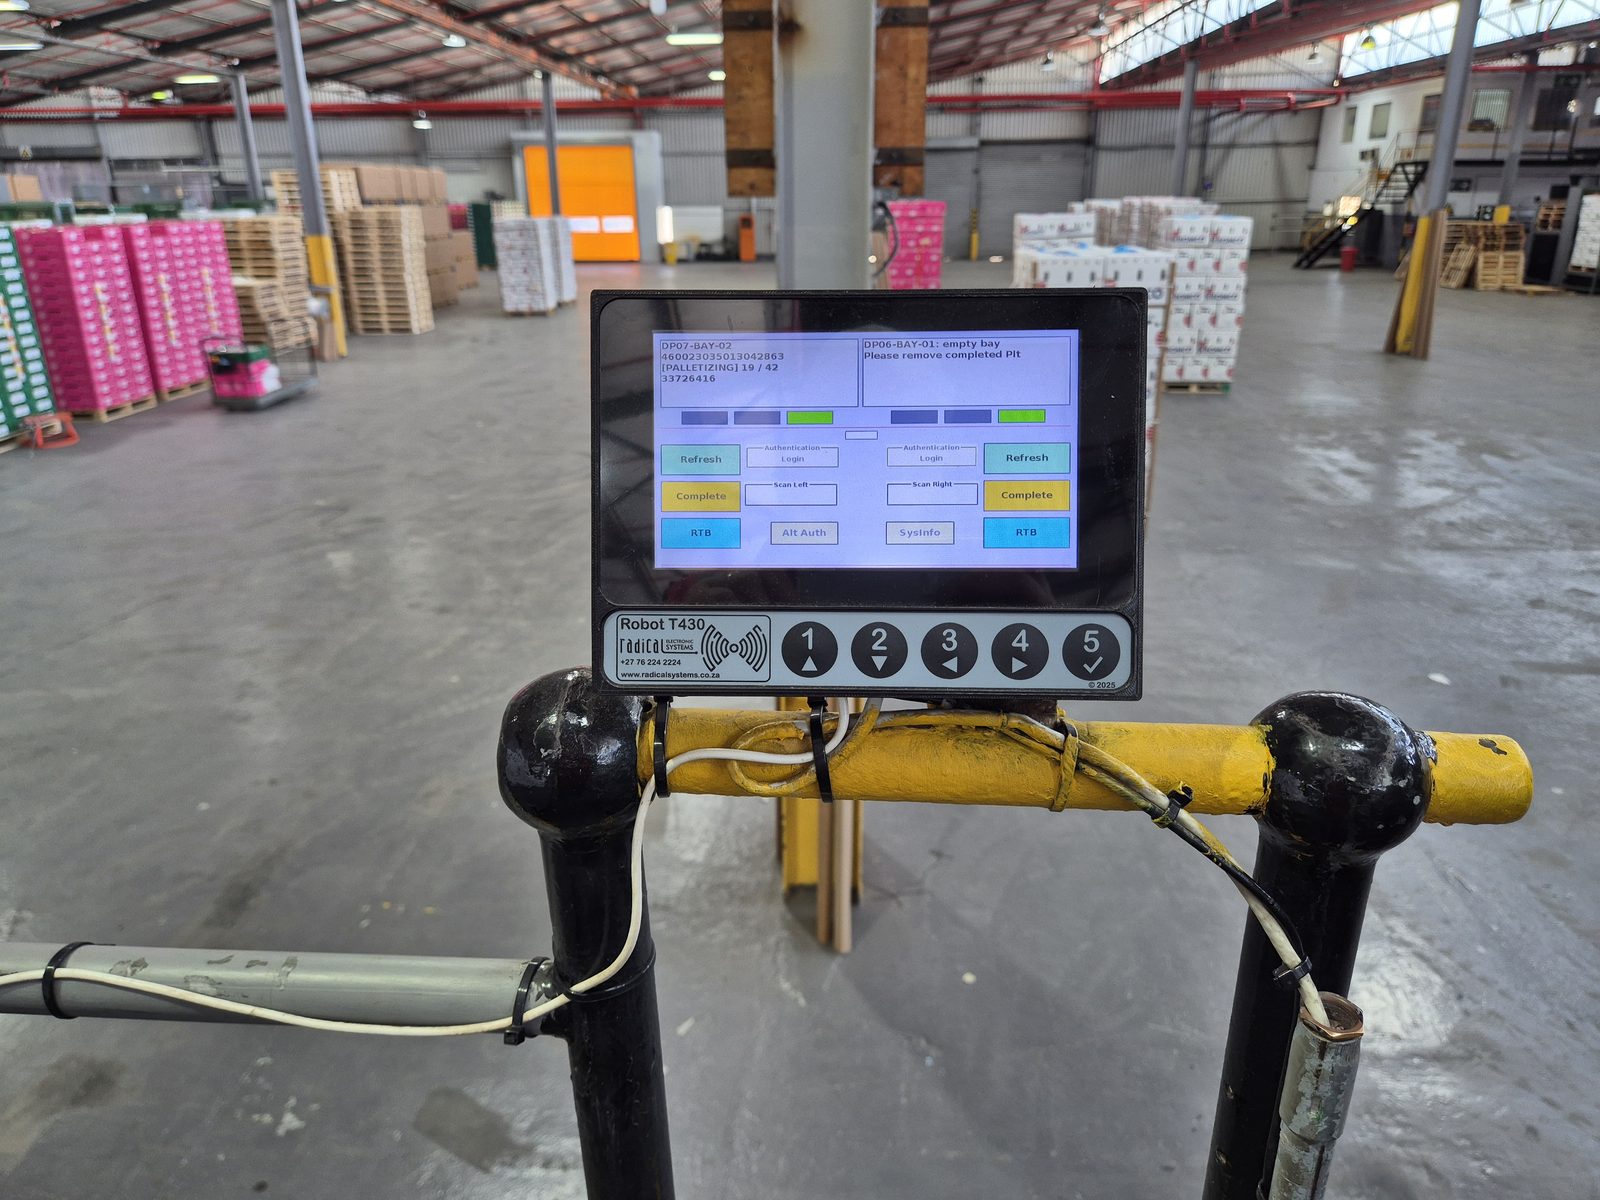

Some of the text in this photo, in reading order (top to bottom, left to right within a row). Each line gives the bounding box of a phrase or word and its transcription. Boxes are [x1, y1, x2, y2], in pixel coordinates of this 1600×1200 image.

[662, 342, 732, 350] DP07-BAY-02
[864, 340, 1000, 350] DP06-BAY-01: empty bay
[662, 353, 784, 361] 460023035013042863
[864, 351, 899, 360] Please
[945, 350, 1002, 360] completed
[662, 364, 738, 372] [PALLETIZING]
[661, 375, 716, 383] 33726416
[681, 455, 722, 463] Refresh
[781, 455, 805, 463] Login
[920, 455, 943, 463] Login
[1006, 454, 1048, 462] Refresh
[677, 492, 726, 501] Complete
[1002, 491, 1053, 500] Complete
[691, 529, 711, 537] RTB
[782, 529, 826, 537] Alt Auth
[900, 528, 941, 538] SysInfo
[621, 618, 705, 630] Robot T430
[801, 628, 813, 650] 1
[872, 628, 888, 650] 2
[942, 629, 958, 651] 3
[1011, 629, 1030, 652] 4
[1083, 630, 1100, 653] 5
[620, 639, 665, 653] radical
[621, 671, 720, 679] www.radicalsystems.co.za
